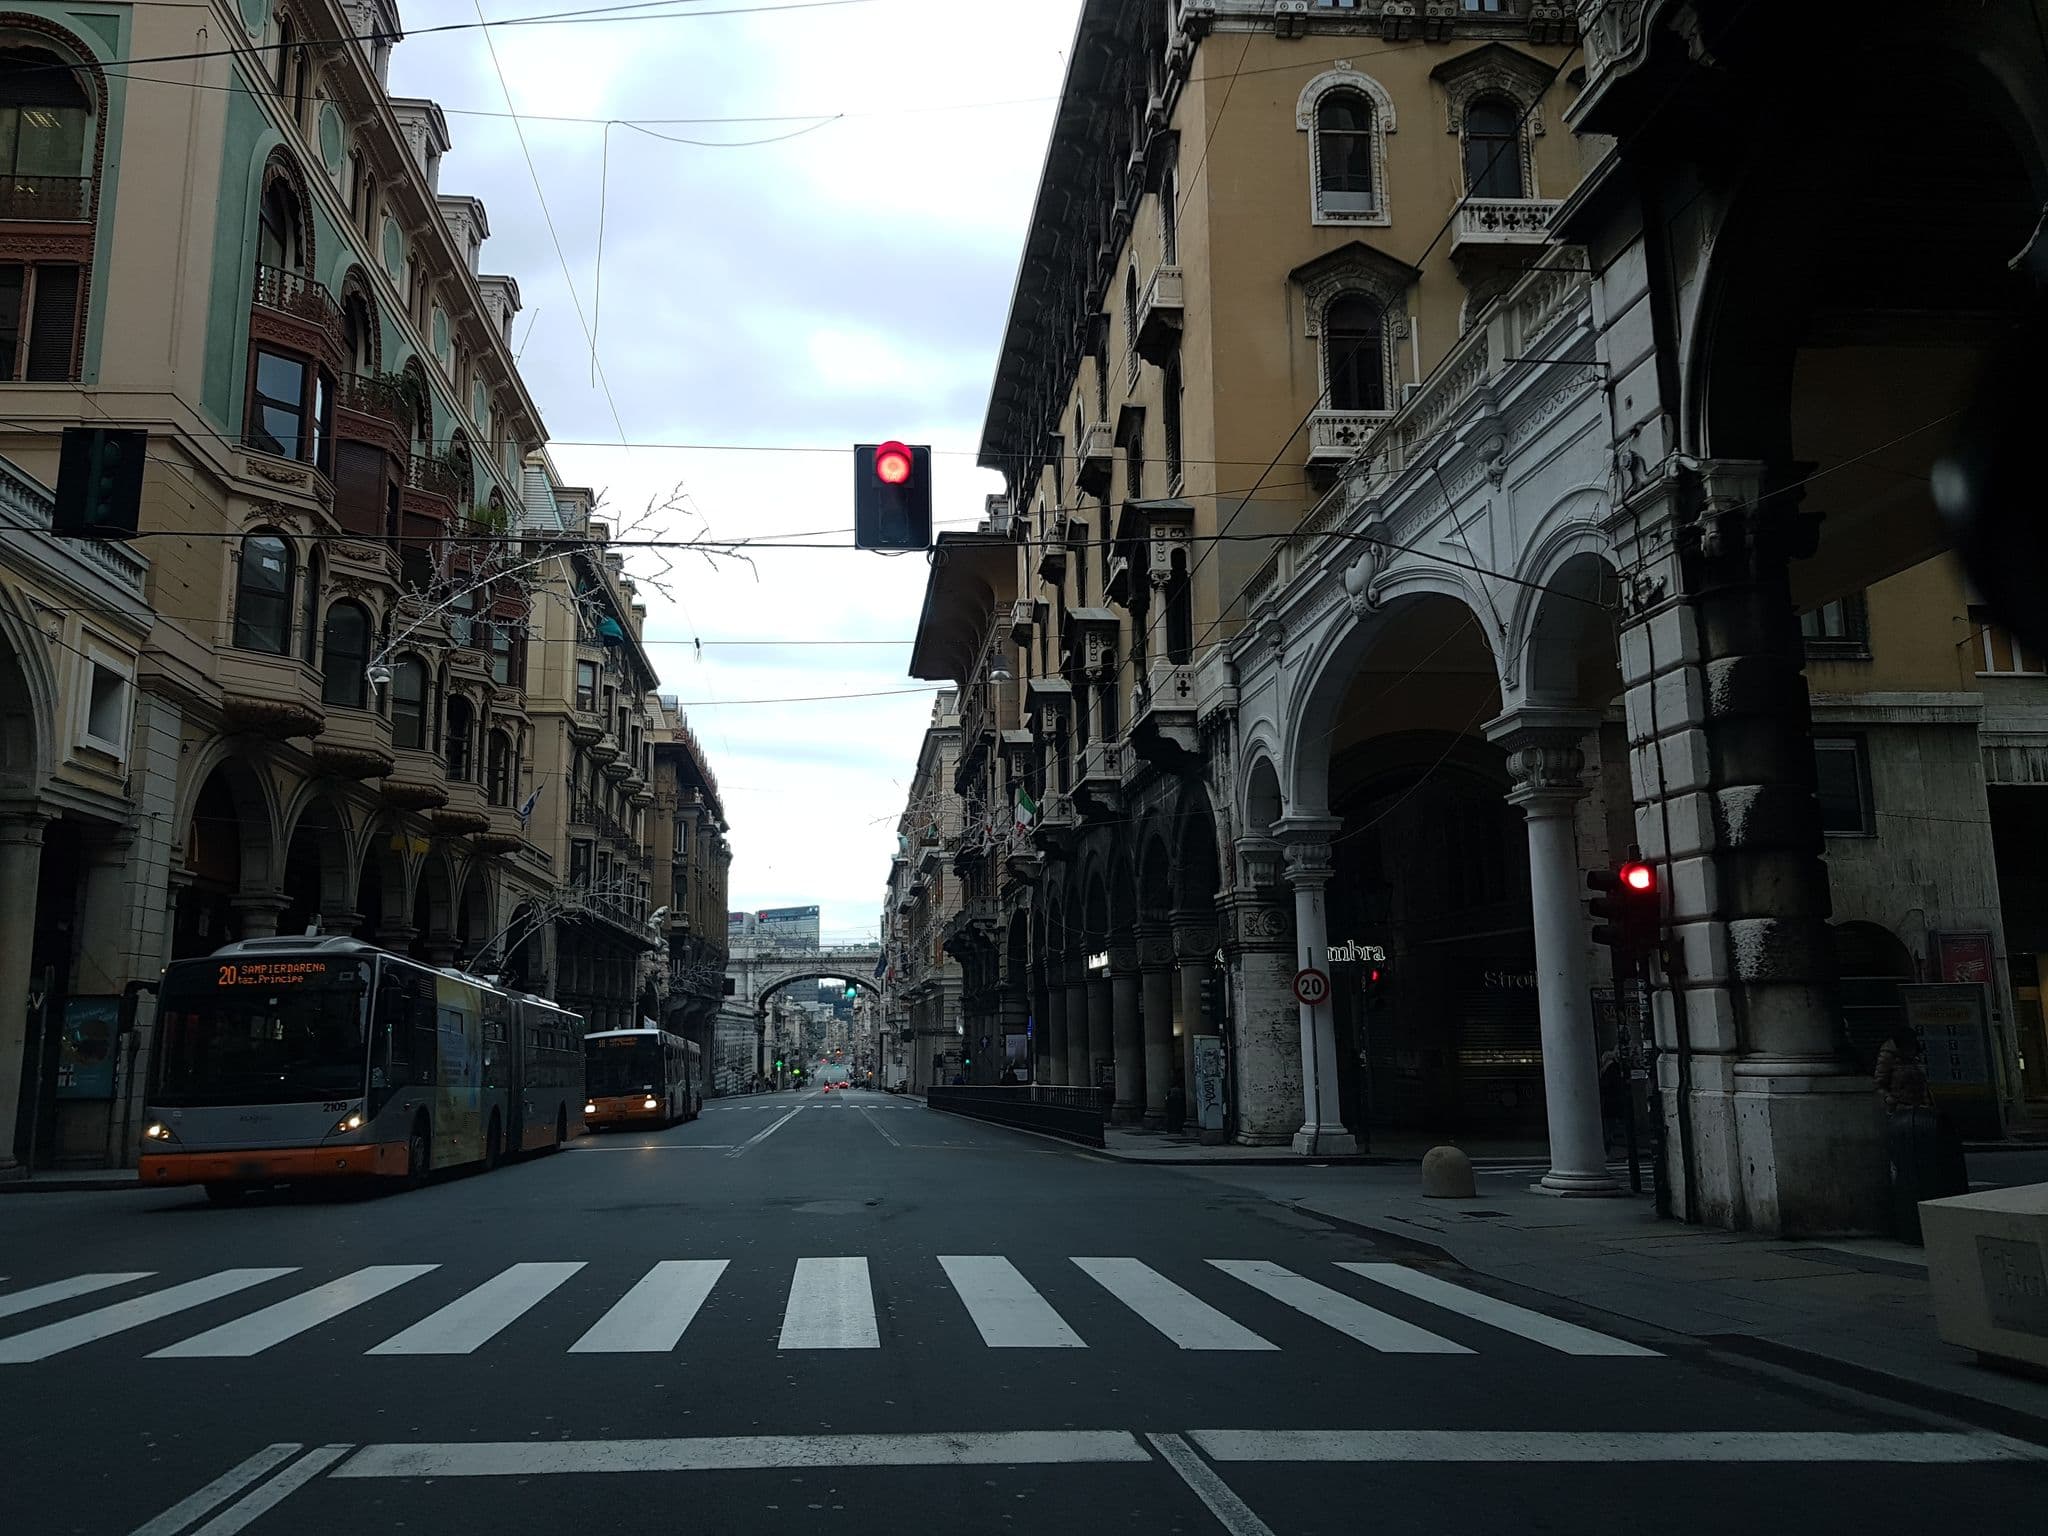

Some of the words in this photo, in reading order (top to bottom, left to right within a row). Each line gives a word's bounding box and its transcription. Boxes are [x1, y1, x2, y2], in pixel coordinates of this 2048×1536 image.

[218, 965, 238, 985] 20
[241, 963, 326, 975] SAMPIERDARENA
[1301, 979, 1322, 995] 20
[323, 1102, 347, 1113] 2109
